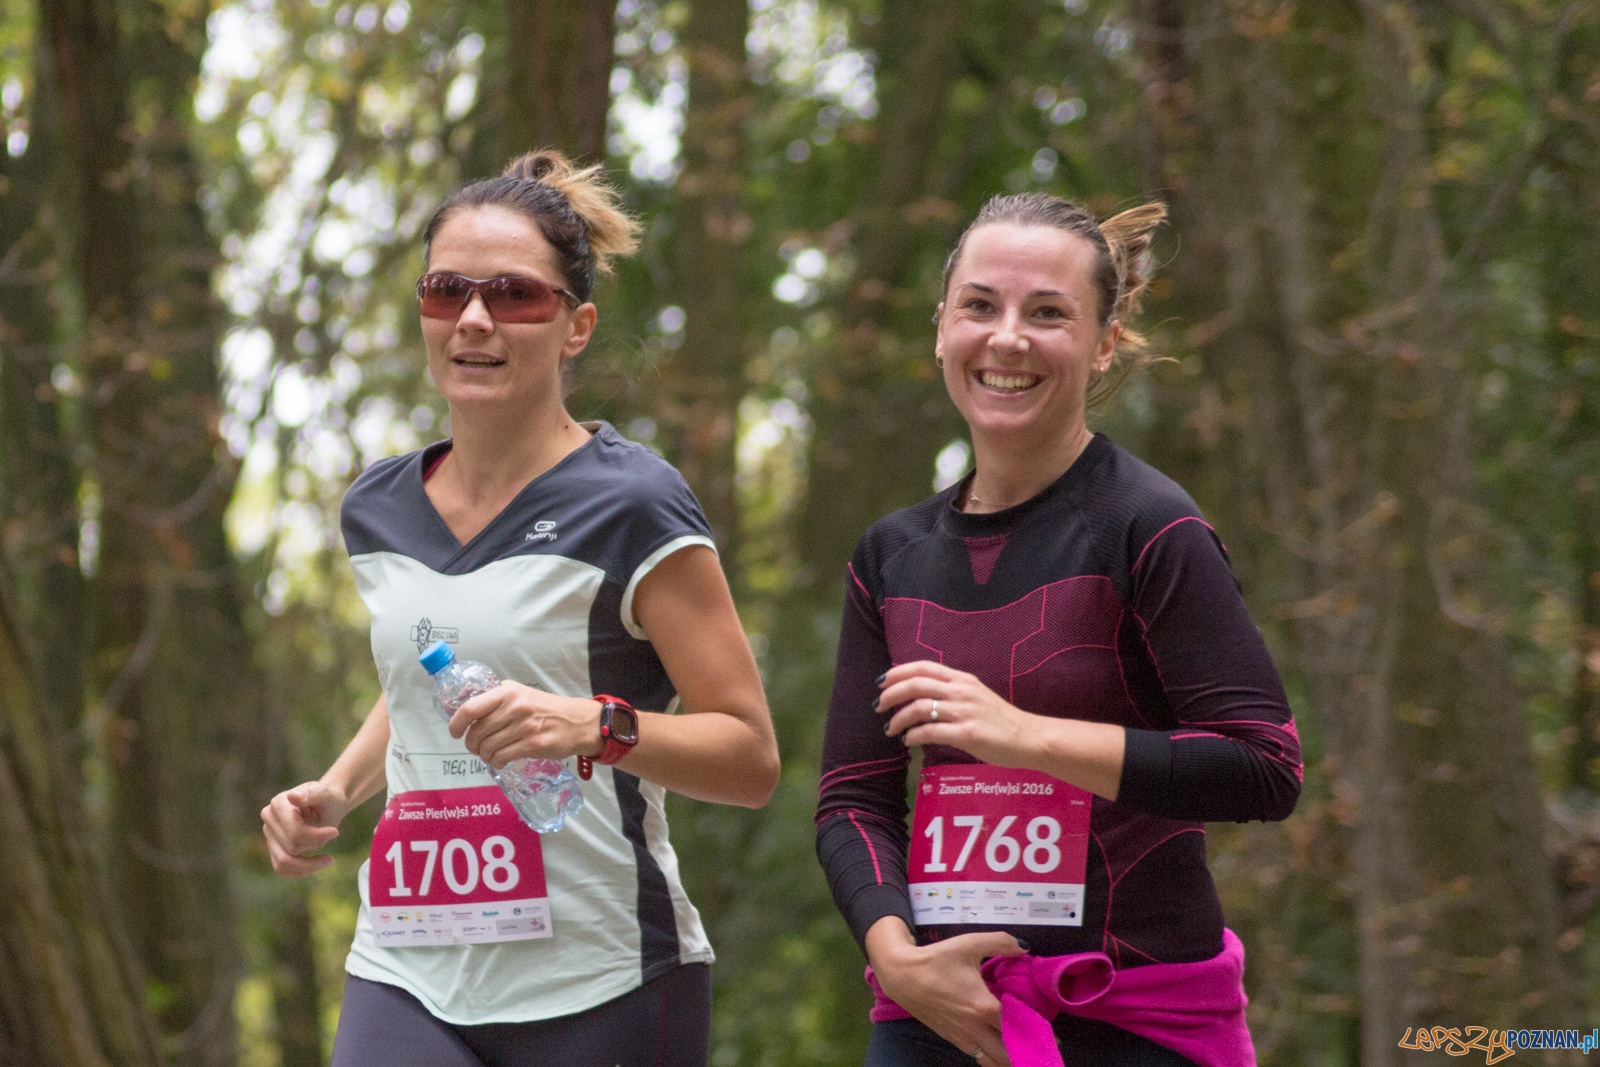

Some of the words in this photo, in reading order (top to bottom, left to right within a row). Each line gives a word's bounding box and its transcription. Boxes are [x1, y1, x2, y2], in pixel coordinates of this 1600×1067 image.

[443, 760, 467, 775] BIEG
[939, 782, 972, 795] Zawsze
[974, 781, 1020, 796] Pier(w)si
[1022, 782, 1054, 795] 2016
[398, 808, 425, 820] Zawsze
[425, 805, 469, 820] Pier(w)si
[470, 803, 501, 817] 2016
[924, 815, 1062, 874] 1768
[385, 835, 520, 897] 1708
